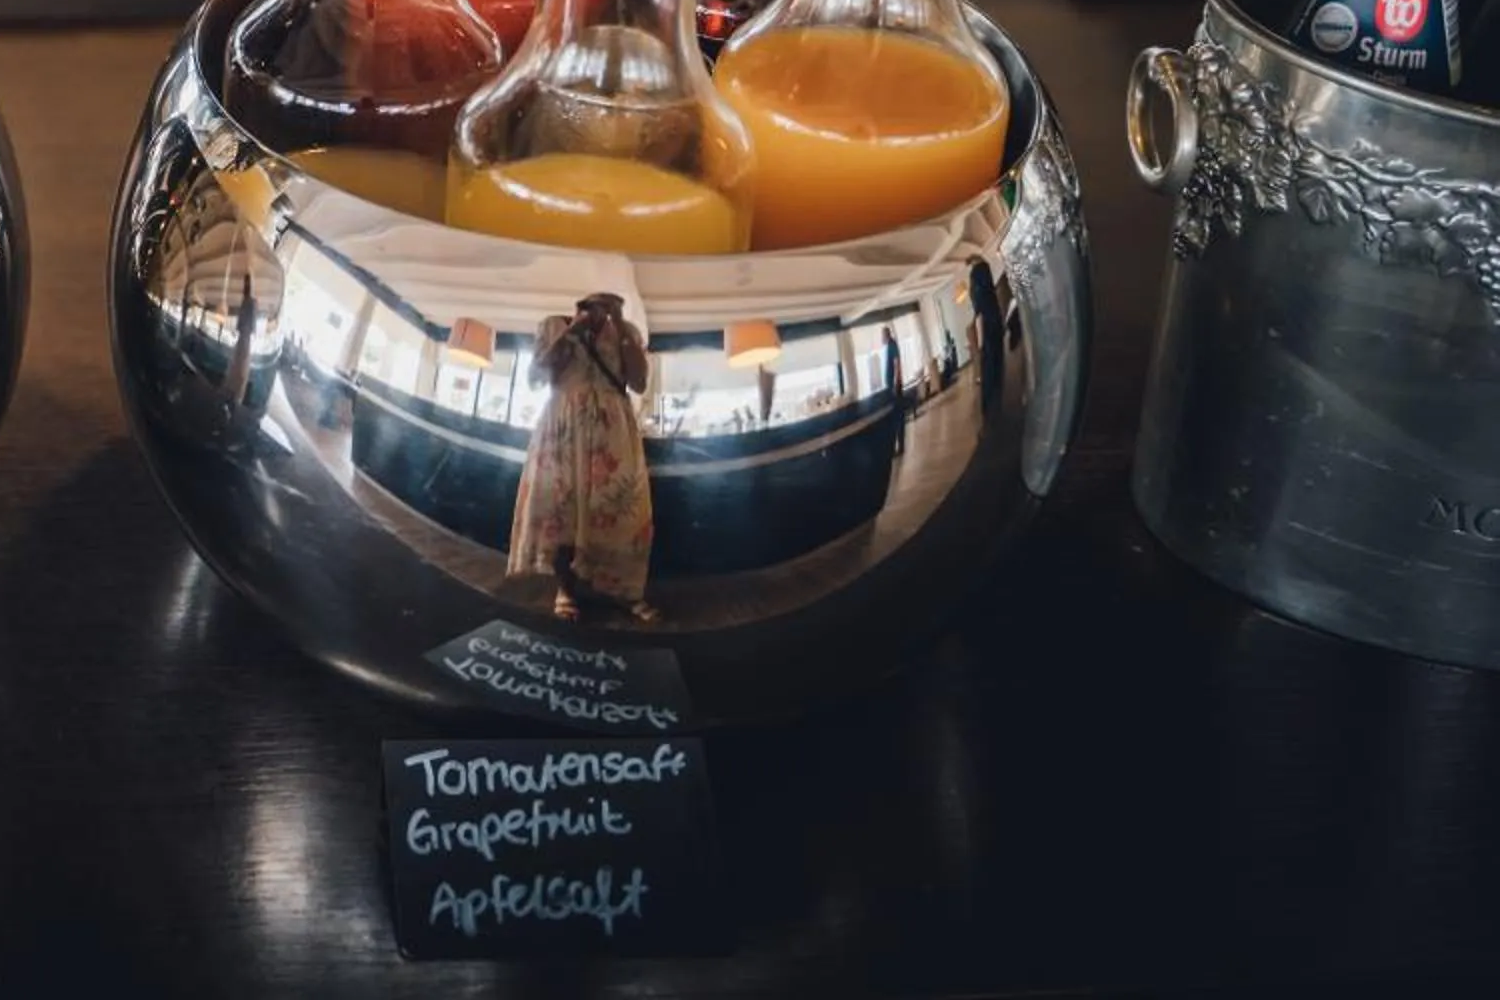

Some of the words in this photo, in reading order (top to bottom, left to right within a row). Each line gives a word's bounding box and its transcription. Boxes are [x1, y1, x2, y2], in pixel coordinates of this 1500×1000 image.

[1356, 35, 1428, 70] Sturm
[403, 743, 687, 798] Tomatensaft
[405, 796, 633, 862] Grapefruit
[428, 866, 650, 938] Apfelsaft
